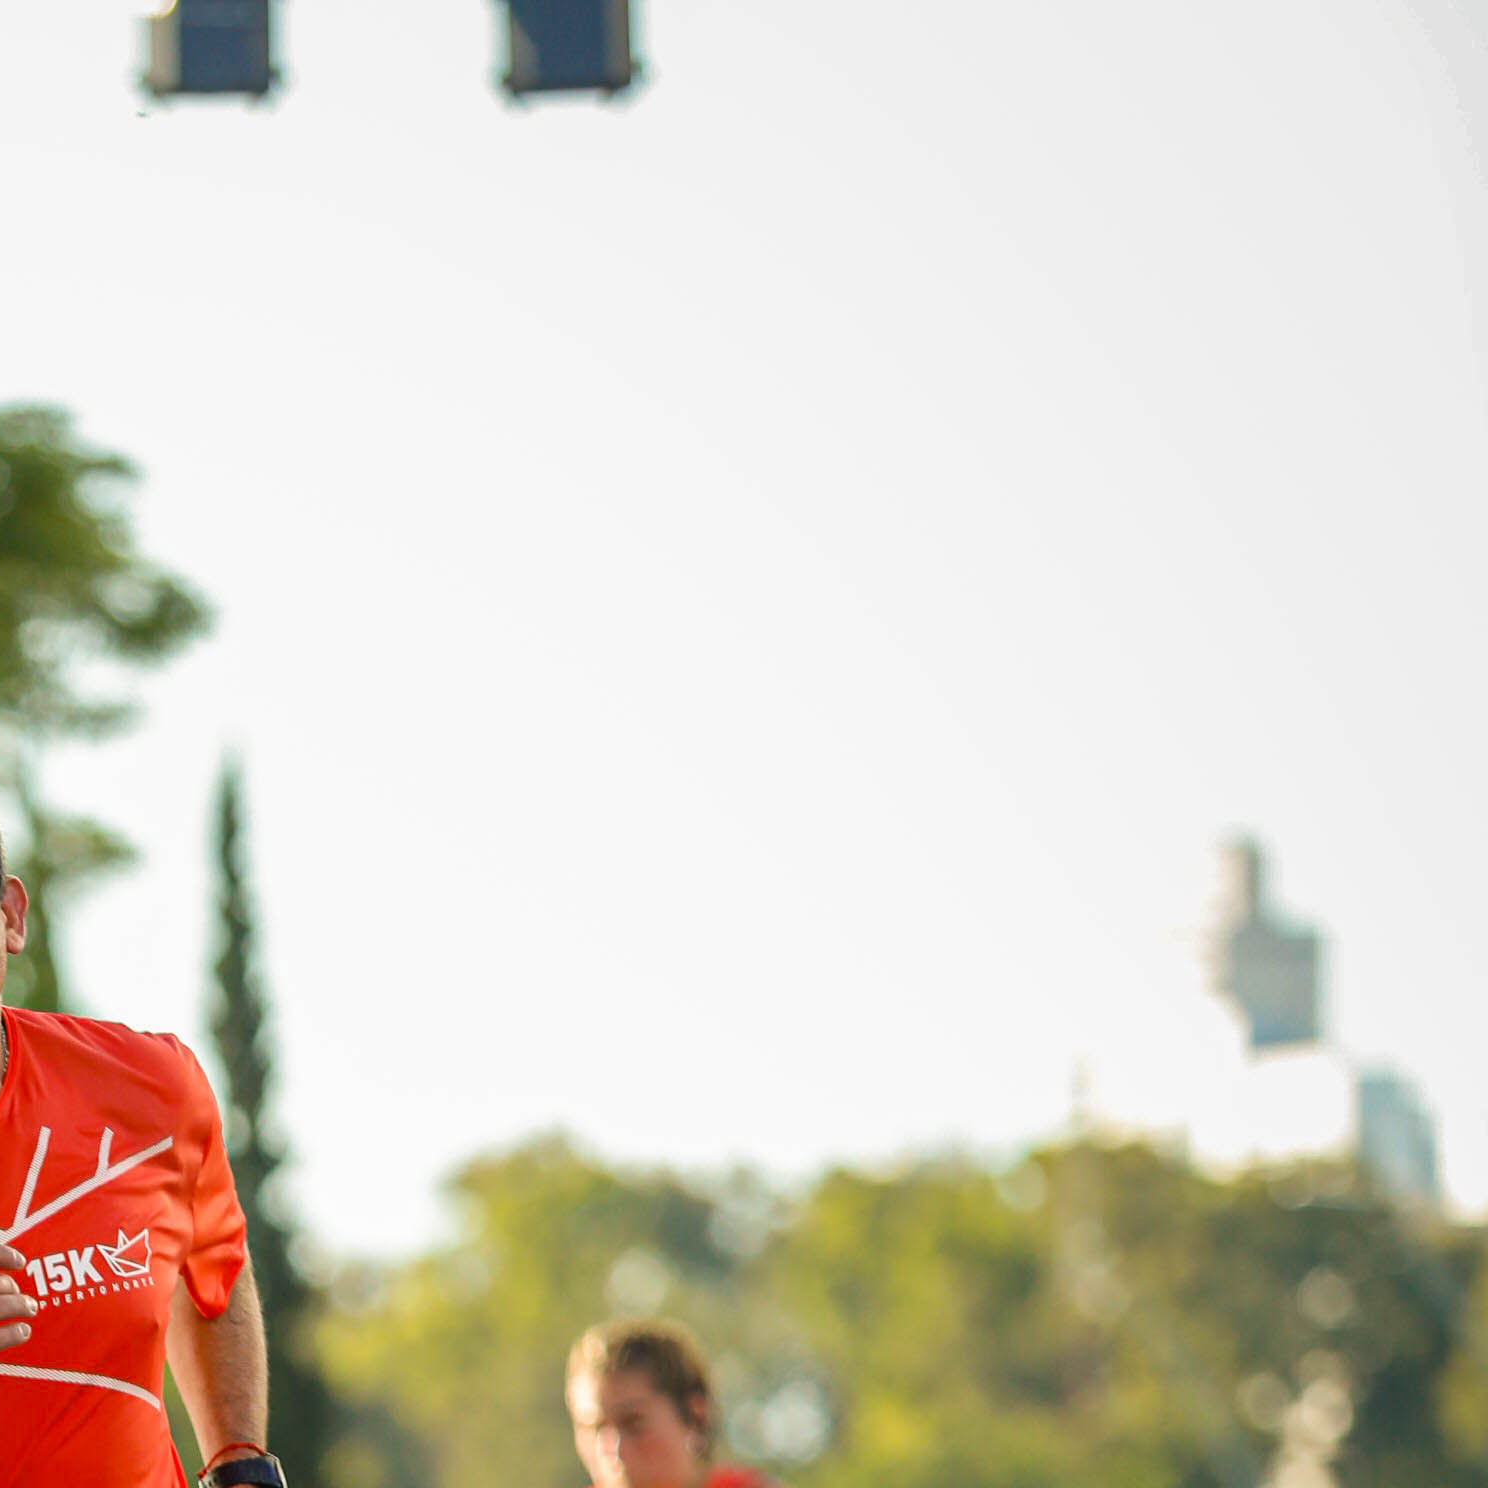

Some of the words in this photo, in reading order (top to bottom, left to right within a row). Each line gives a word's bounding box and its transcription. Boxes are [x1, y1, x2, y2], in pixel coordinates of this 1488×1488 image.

[26, 1246, 104, 1297] 15K
[39, 1285, 107, 1310] PUERTO
[111, 1276, 155, 1292] NORTE
